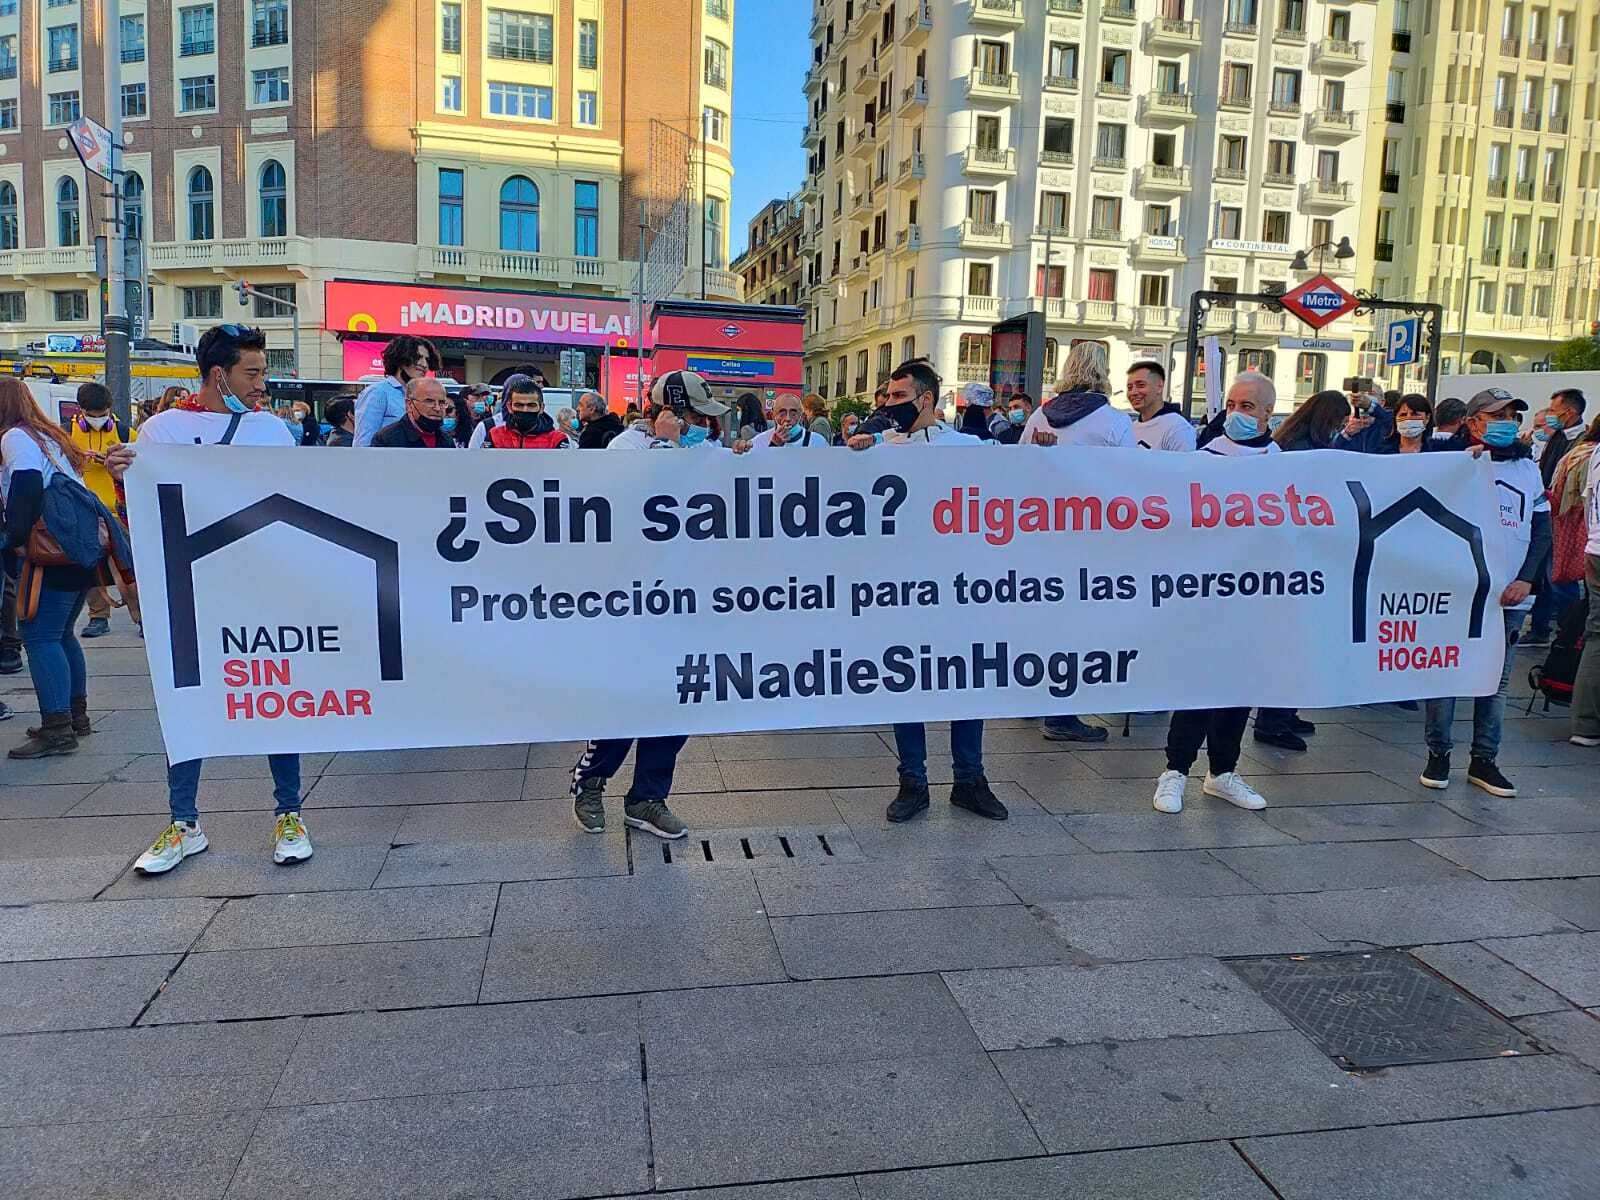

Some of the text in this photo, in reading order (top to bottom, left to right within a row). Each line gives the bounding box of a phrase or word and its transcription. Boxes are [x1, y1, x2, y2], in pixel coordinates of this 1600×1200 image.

[1149, 237, 1175, 248] HOSTAL
[1226, 241, 1289, 252] CONTINENTAL
[1306, 294, 1340, 307] Metro
[400, 301, 632, 337] ¡MADRID VUELA!
[1302, 339, 1332, 348] Callao
[1389, 325, 1408, 361] P
[437, 474, 1335, 563] ¿Sin salida? digamos basta
[450, 568, 1325, 622] Protección social para todas las personas
[1380, 592, 1452, 616] NADIE
[221, 625, 341, 654] NADIE
[1378, 620, 1417, 643] SIN
[223, 658, 291, 687] SIN
[1378, 646, 1459, 671] HOGAR
[676, 642, 1139, 705] #NadieSinHogar
[226, 689, 372, 720] HOGAR
